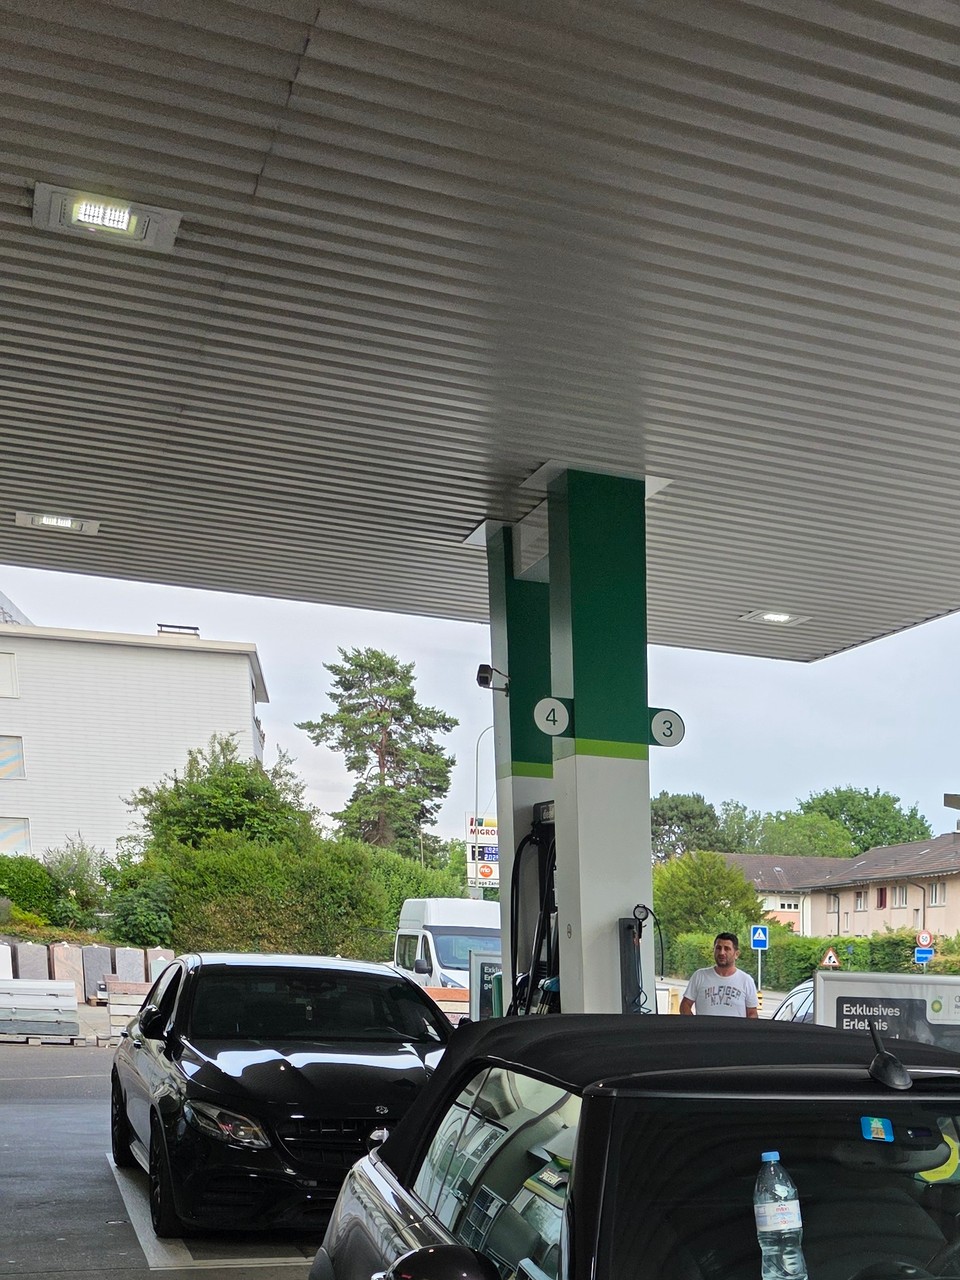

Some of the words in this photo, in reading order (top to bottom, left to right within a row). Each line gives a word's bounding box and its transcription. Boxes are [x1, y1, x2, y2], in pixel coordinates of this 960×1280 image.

[545, 708, 558, 726] 4
[662, 720, 673, 737] 3
[921, 935, 929, 943] 50
[704, 985, 742, 1000] HILFIGER
[843, 1004, 901, 1016] Exklusives
